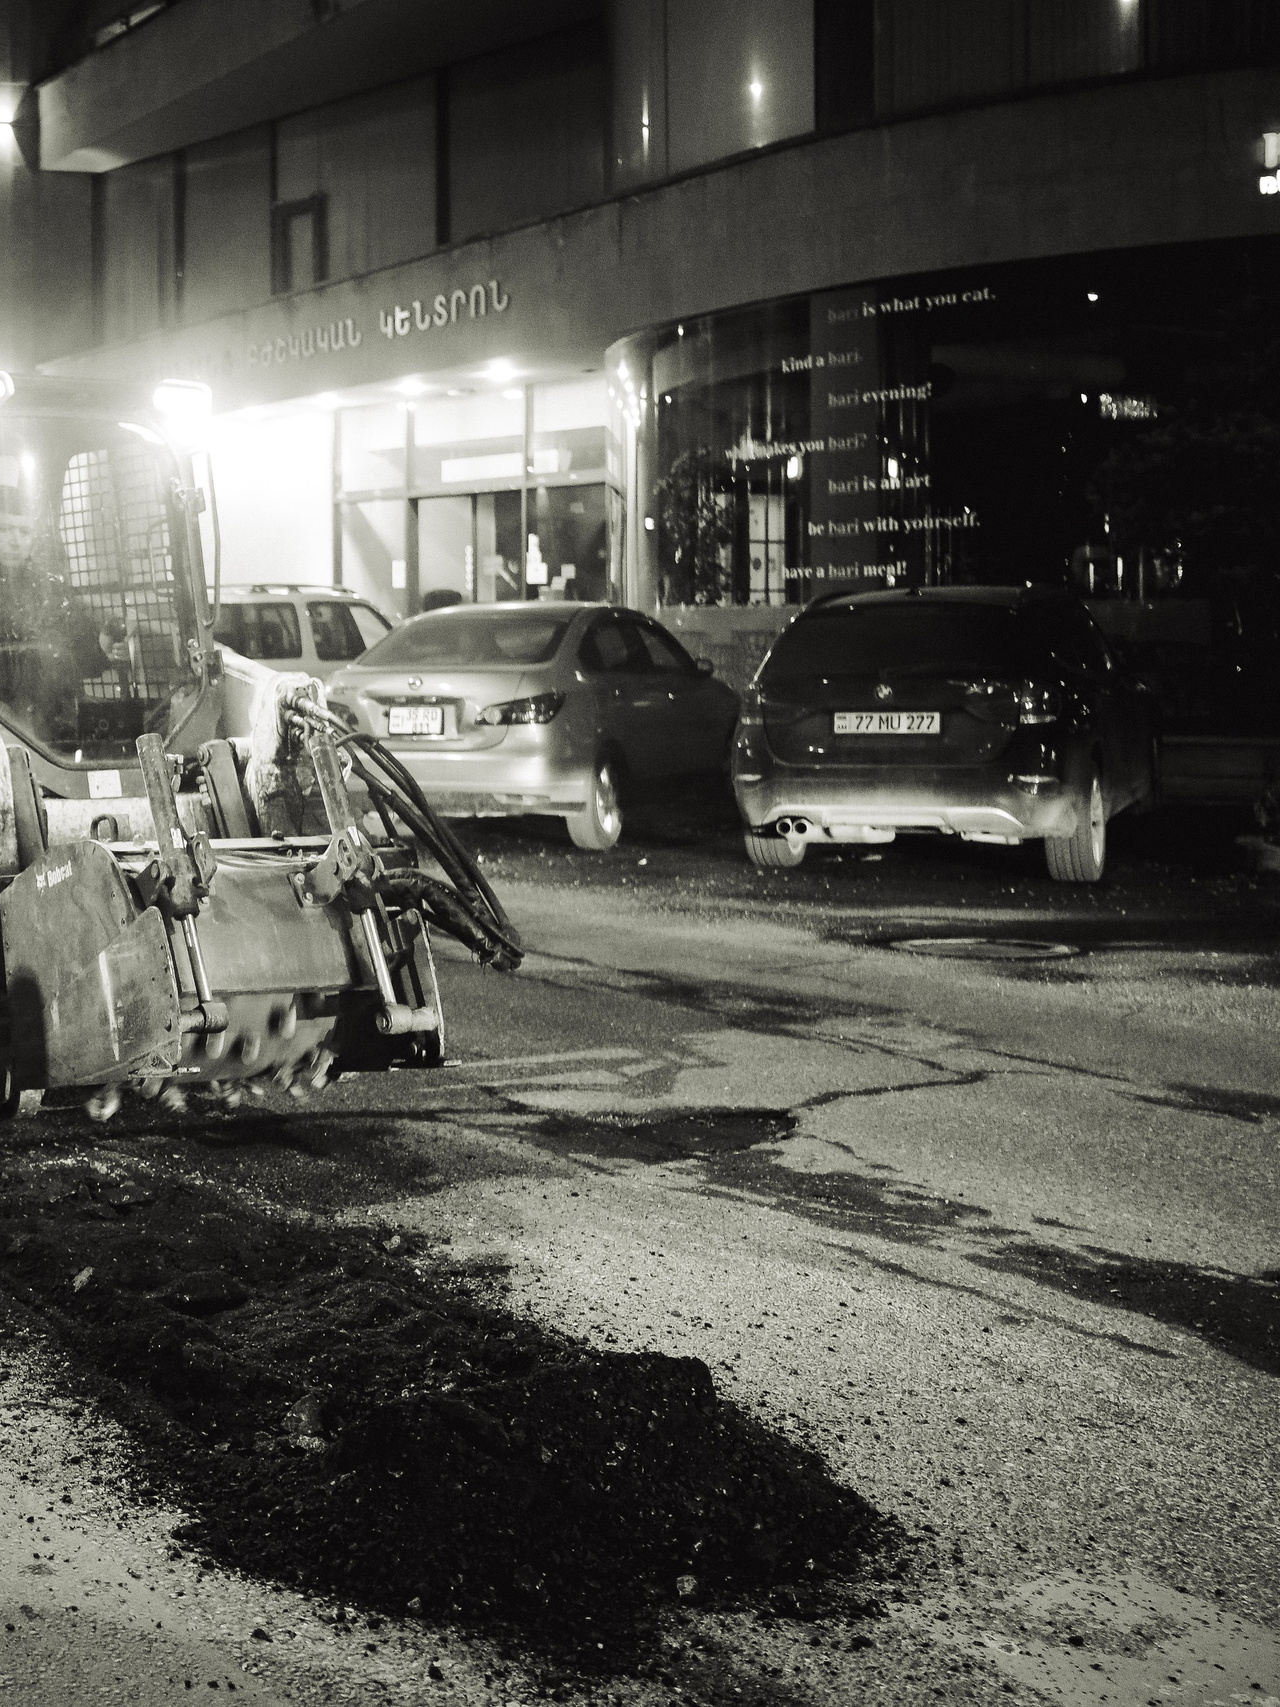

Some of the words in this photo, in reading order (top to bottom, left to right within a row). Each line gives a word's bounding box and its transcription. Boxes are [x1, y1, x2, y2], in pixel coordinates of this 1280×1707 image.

[379, 279, 509, 340] ԿԵՆՏՐՈՆ
[862, 301, 877, 318] is
[880, 296, 921, 314] what
[925, 293, 957, 311] you
[781, 354, 813, 374] kind
[816, 356, 825, 368] a
[828, 389, 859, 409] bari
[862, 381, 932, 403] evening!
[828, 476, 859, 495] bari
[863, 475, 877, 491] is
[880, 478, 901, 490] an
[905, 474, 931, 489] art
[808, 520, 825, 536] be
[828, 517, 859, 536] bari
[863, 516, 899, 532] with
[816, 567, 825, 579] a
[828, 561, 859, 579] bari
[863, 560, 908, 577] meal!
[855, 715, 874, 730] 77
[878, 715, 901, 730] MU
[906, 715, 935, 731] 277
[47, 859, 73, 888] Bobcat
